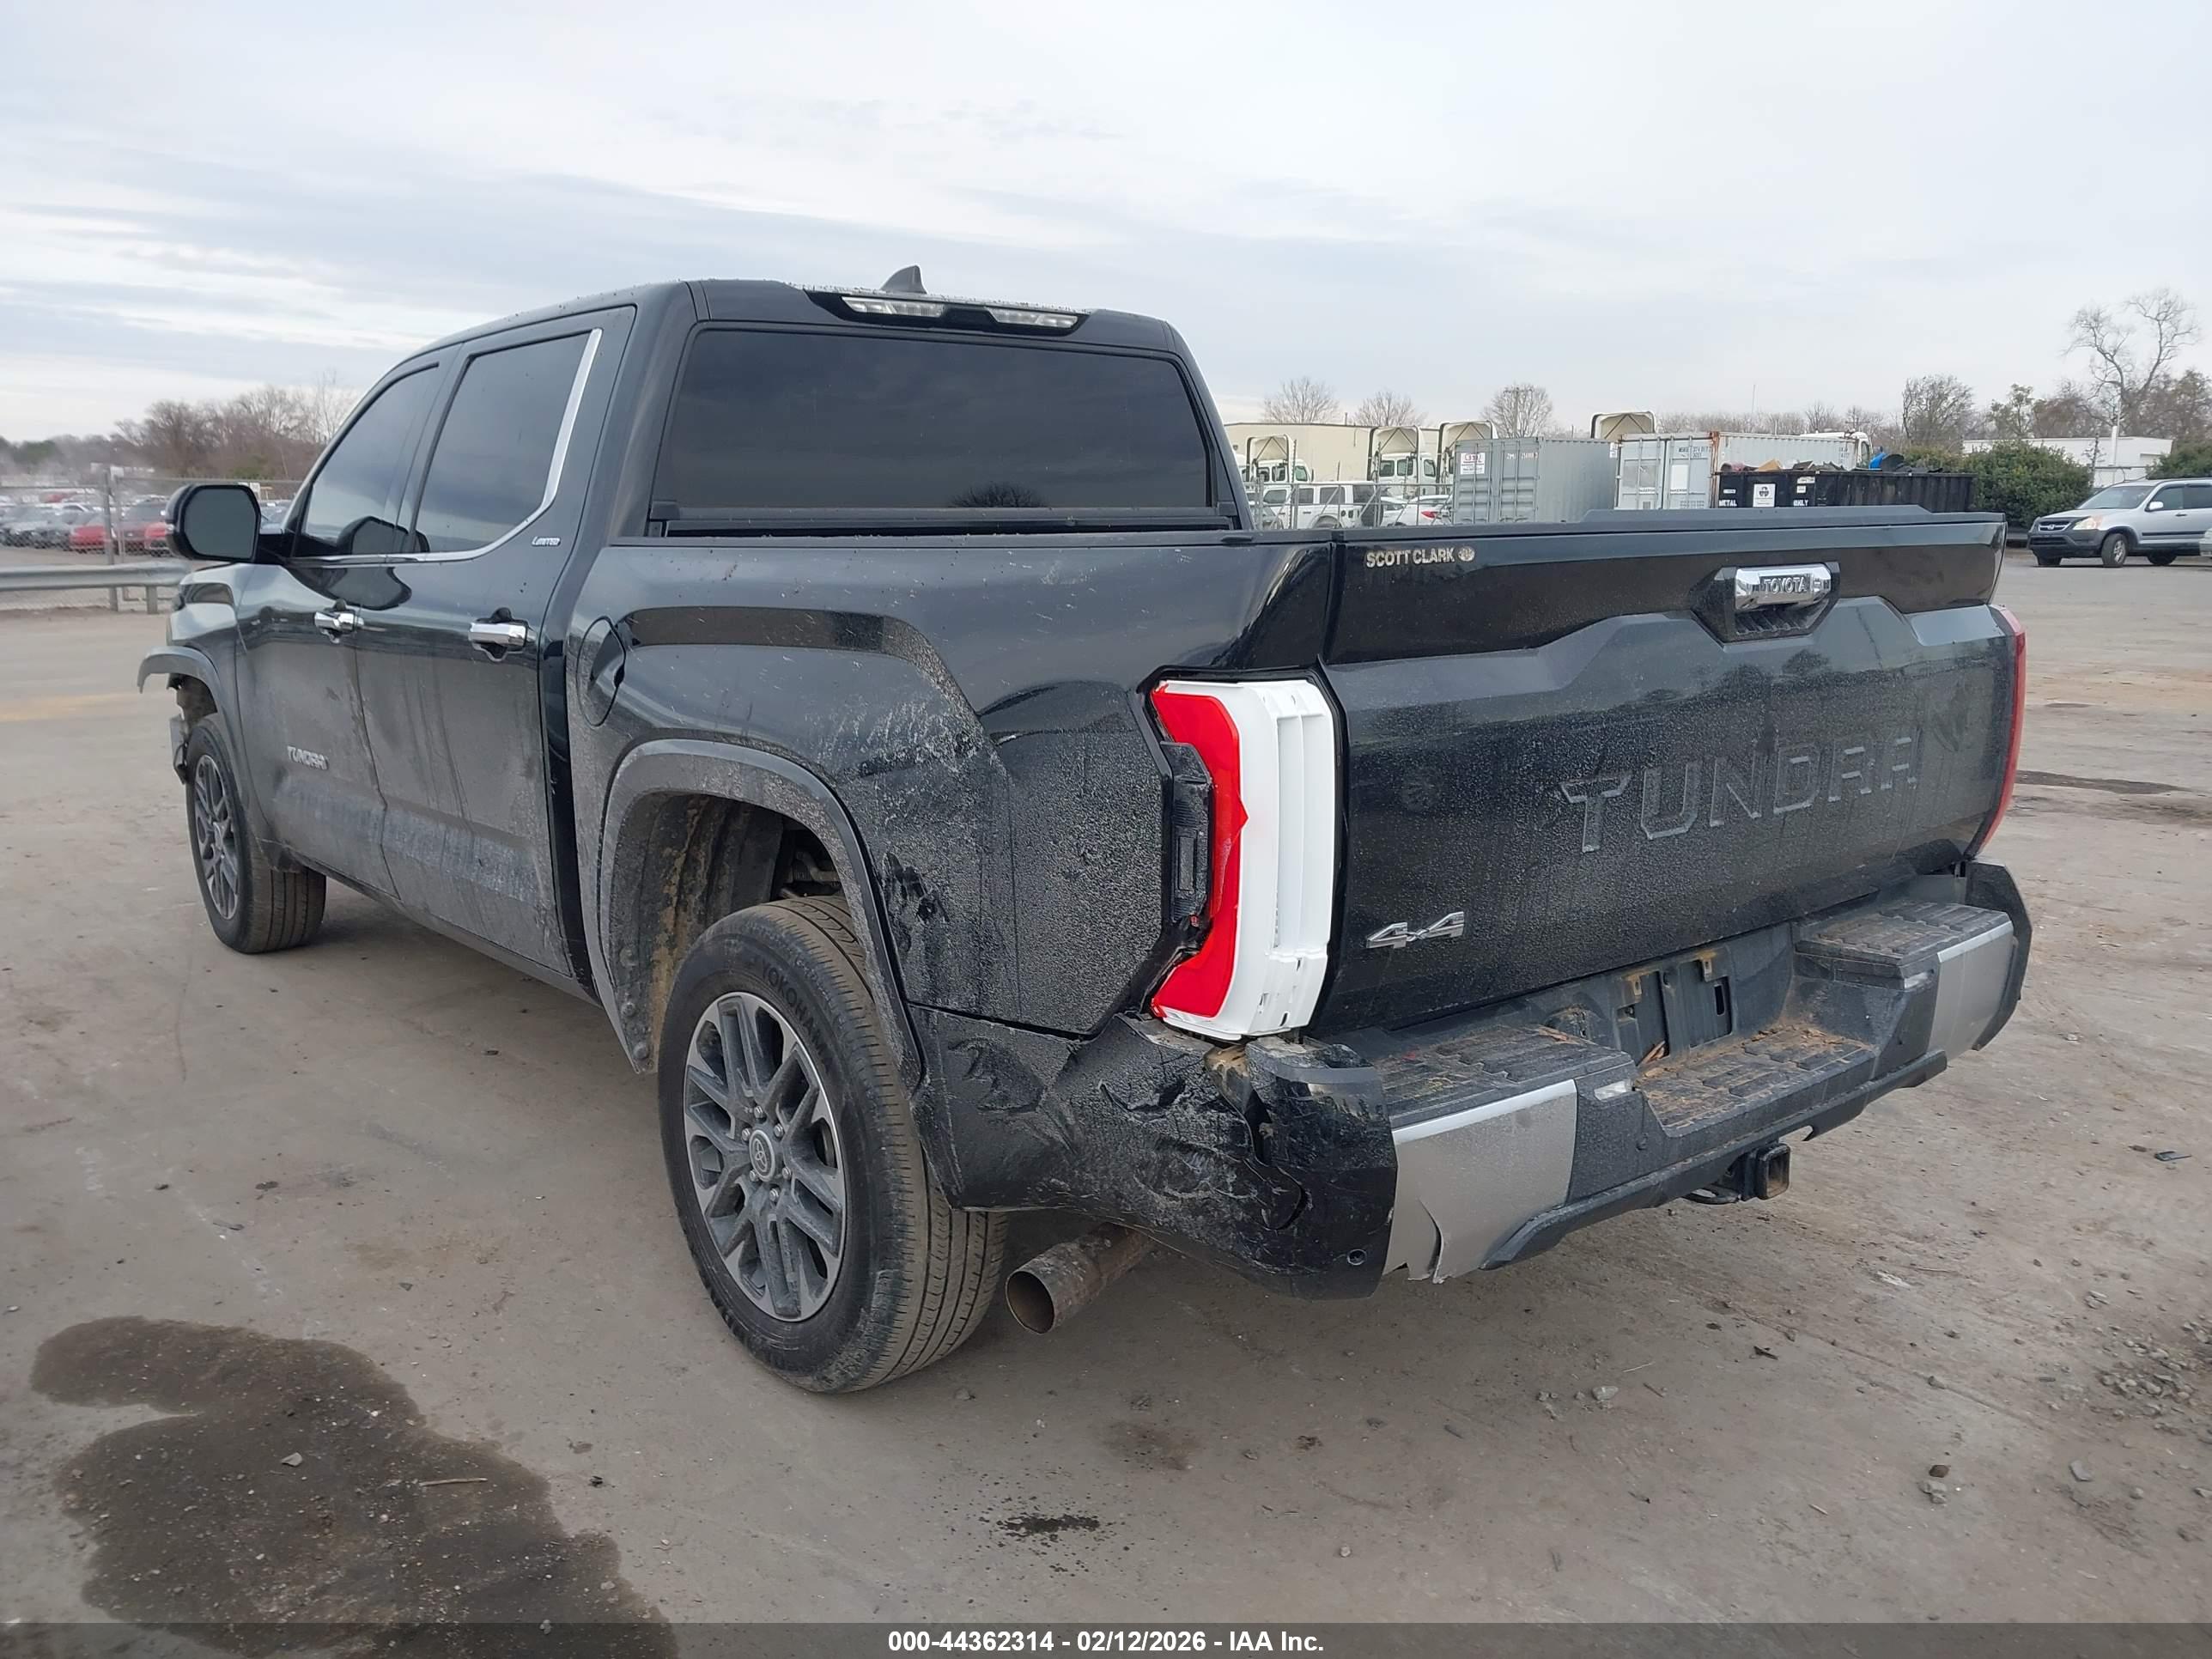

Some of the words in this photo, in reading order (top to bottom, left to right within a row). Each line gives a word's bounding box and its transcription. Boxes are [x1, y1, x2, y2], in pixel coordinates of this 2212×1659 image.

[1718, 499, 1738, 507] METAL
[1793, 499, 1808, 507] ONLY
[1366, 550, 1411, 568] SCOTT
[1413, 547, 1455, 564] CLARK
[1763, 576, 1808, 595] TOYOTA
[287, 744, 330, 770] TUNDRA
[1560, 726, 1923, 853] TUNDRA
